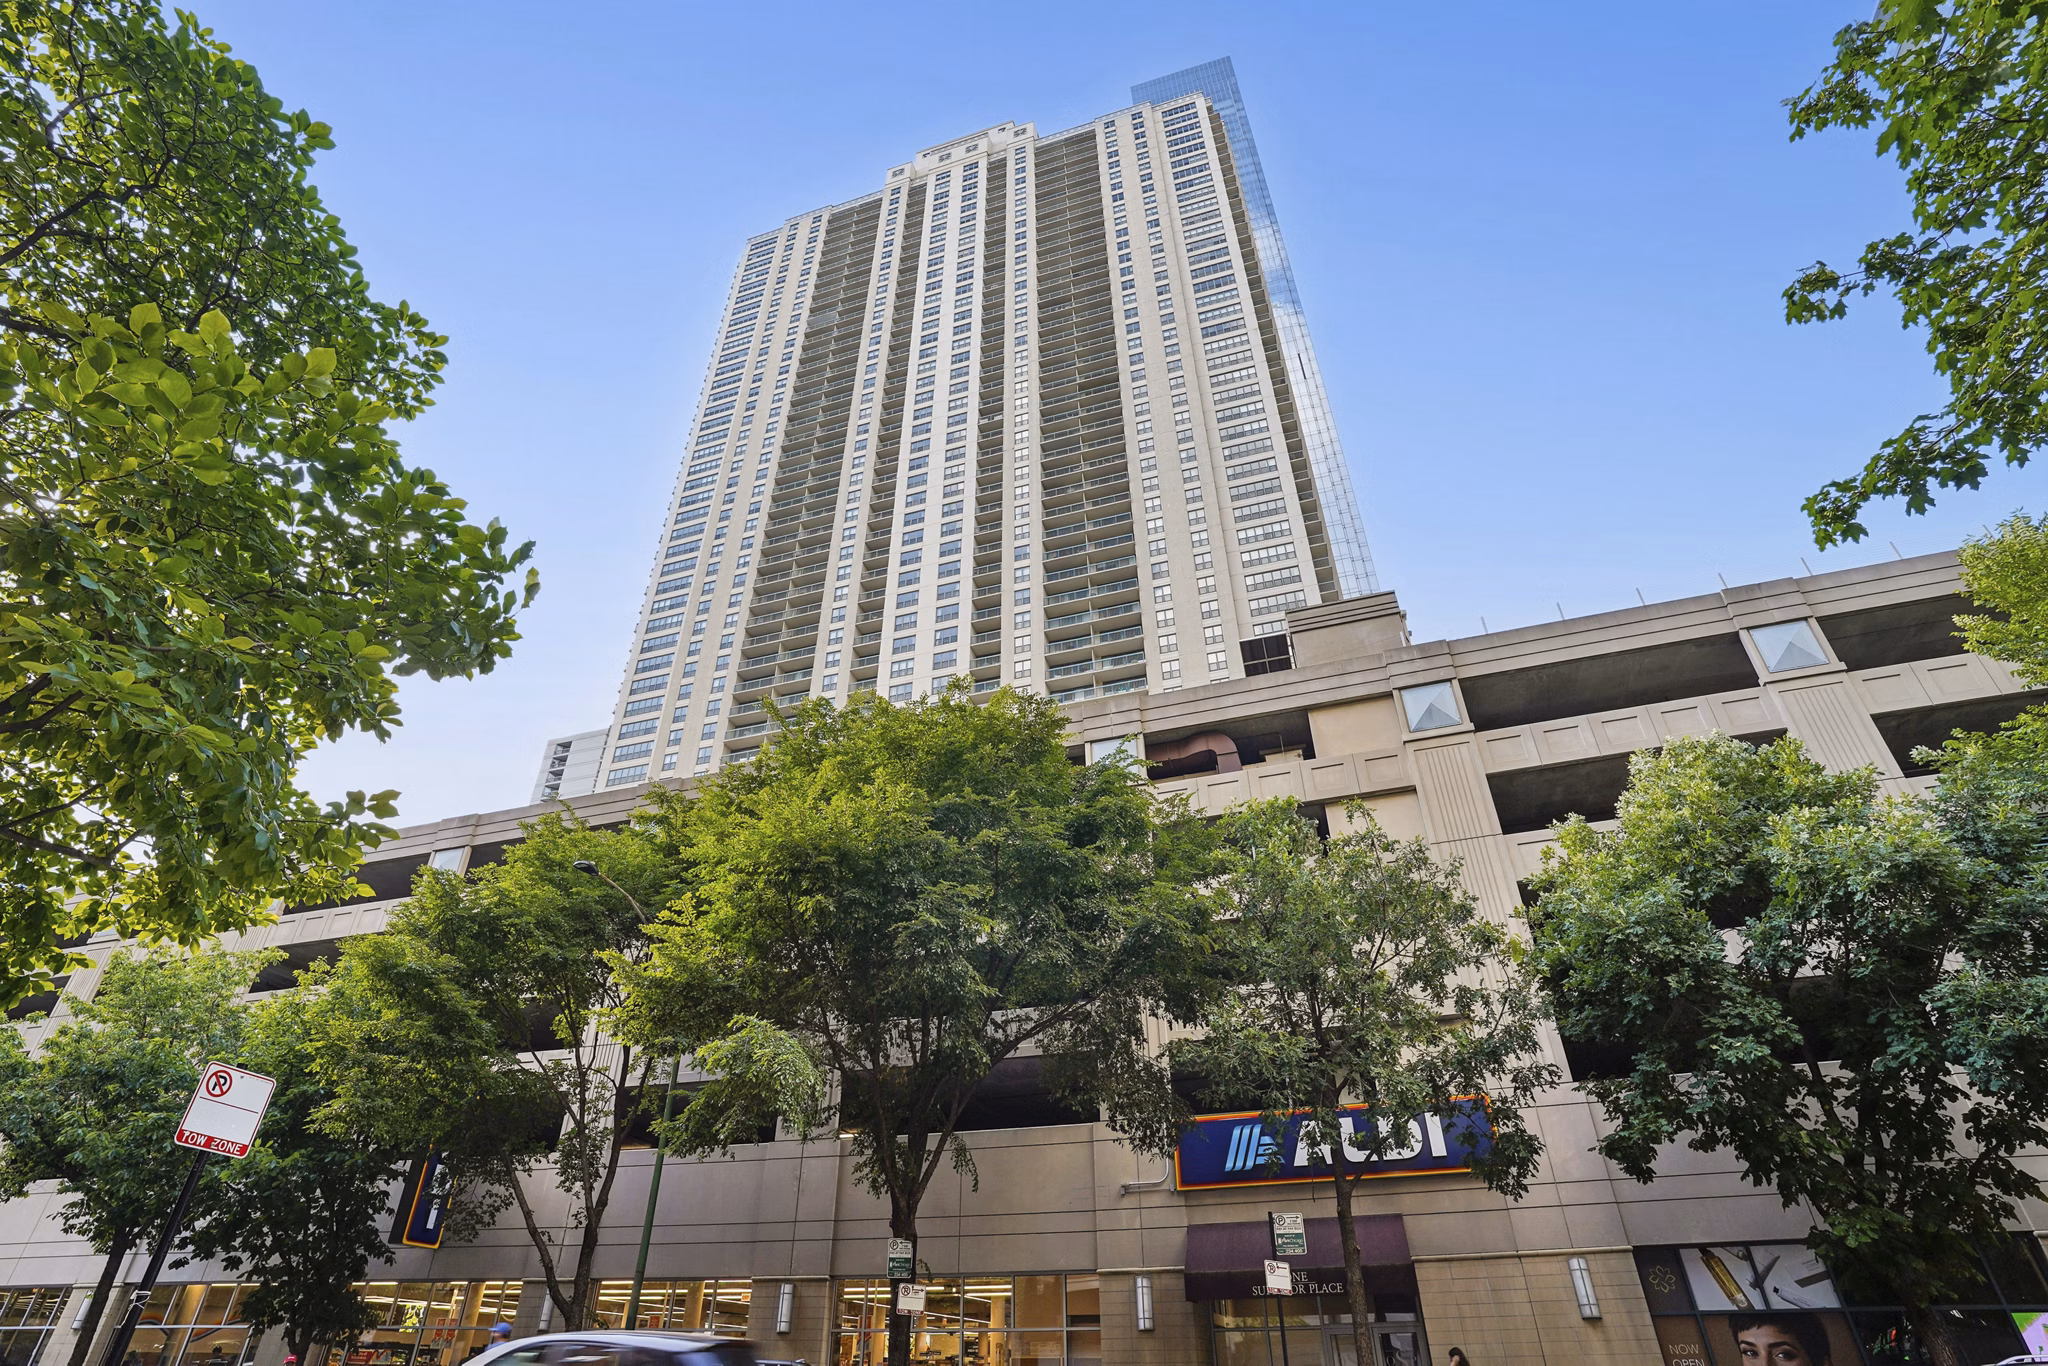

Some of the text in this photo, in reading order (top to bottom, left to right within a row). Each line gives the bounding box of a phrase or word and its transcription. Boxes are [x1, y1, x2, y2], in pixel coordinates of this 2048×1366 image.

[182, 1131, 243, 1155] TOW ZONE
[1294, 1111, 1448, 1167] ALDI
[1290, 1271, 1309, 1282] NE
[1309, 1283, 1344, 1294] PLACE
[1668, 1344, 1699, 1355] NOW
[1672, 1358, 1705, 1366] OPEN
